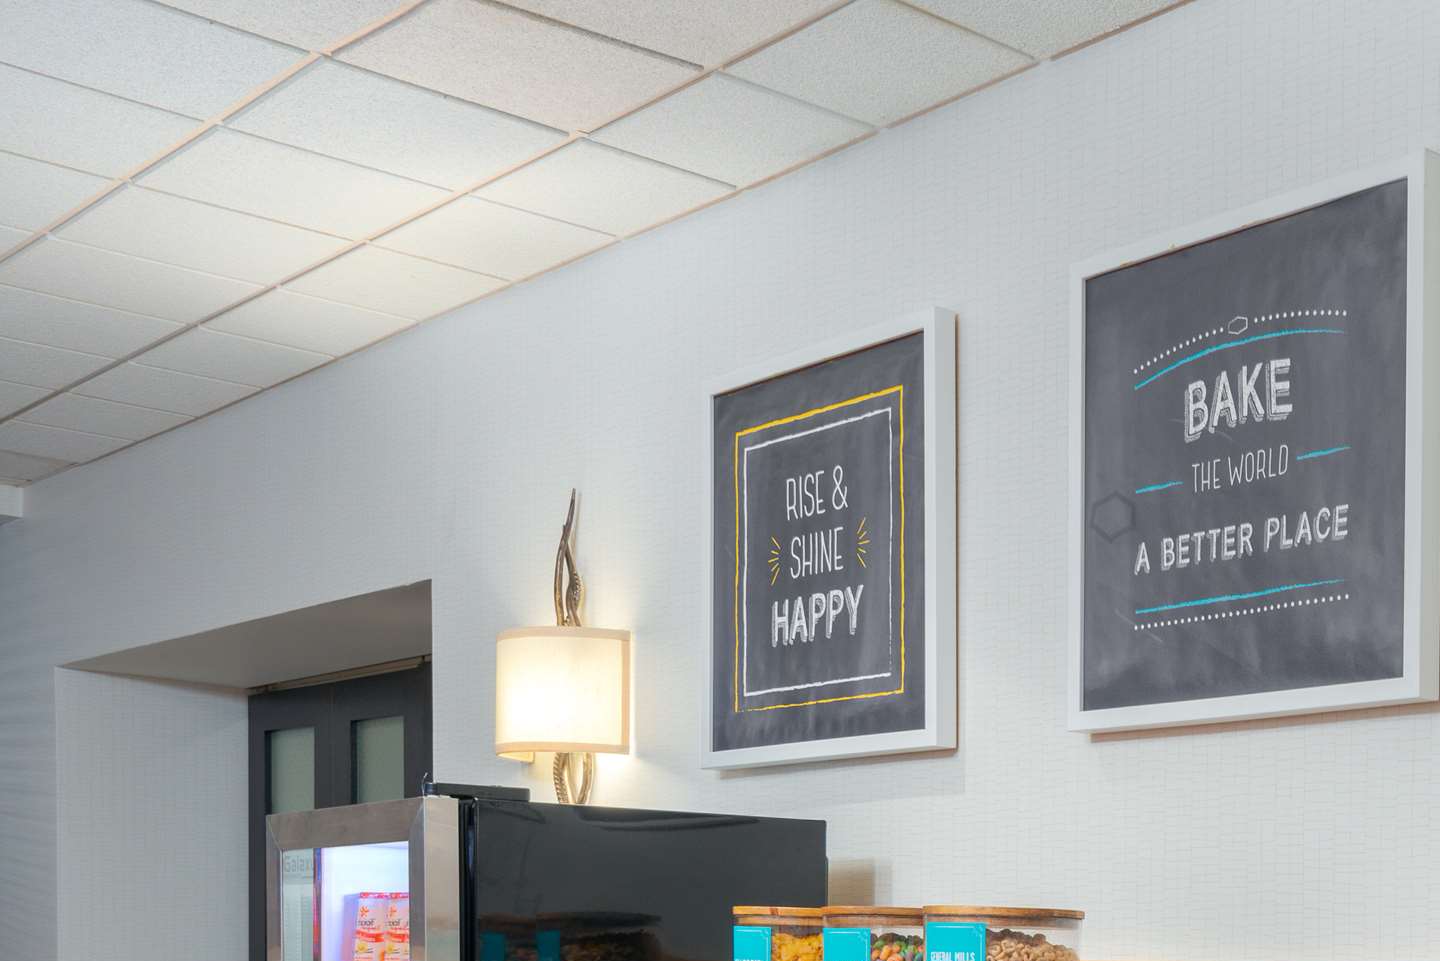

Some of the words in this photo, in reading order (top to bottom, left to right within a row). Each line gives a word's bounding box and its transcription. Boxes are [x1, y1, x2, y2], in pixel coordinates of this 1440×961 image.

[1184, 357, 1294, 444] BAKE
[786, 470, 826, 521] RISE
[833, 464, 849, 511] &
[1191, 462, 1222, 493] THE
[1228, 444, 1290, 485] WORLD
[790, 526, 845, 579] SHINE
[1133, 541, 1151, 575] A
[1161, 522, 1254, 571] BETTER
[1263, 504, 1350, 553] PLACE
[771, 584, 865, 648] HAPPY
